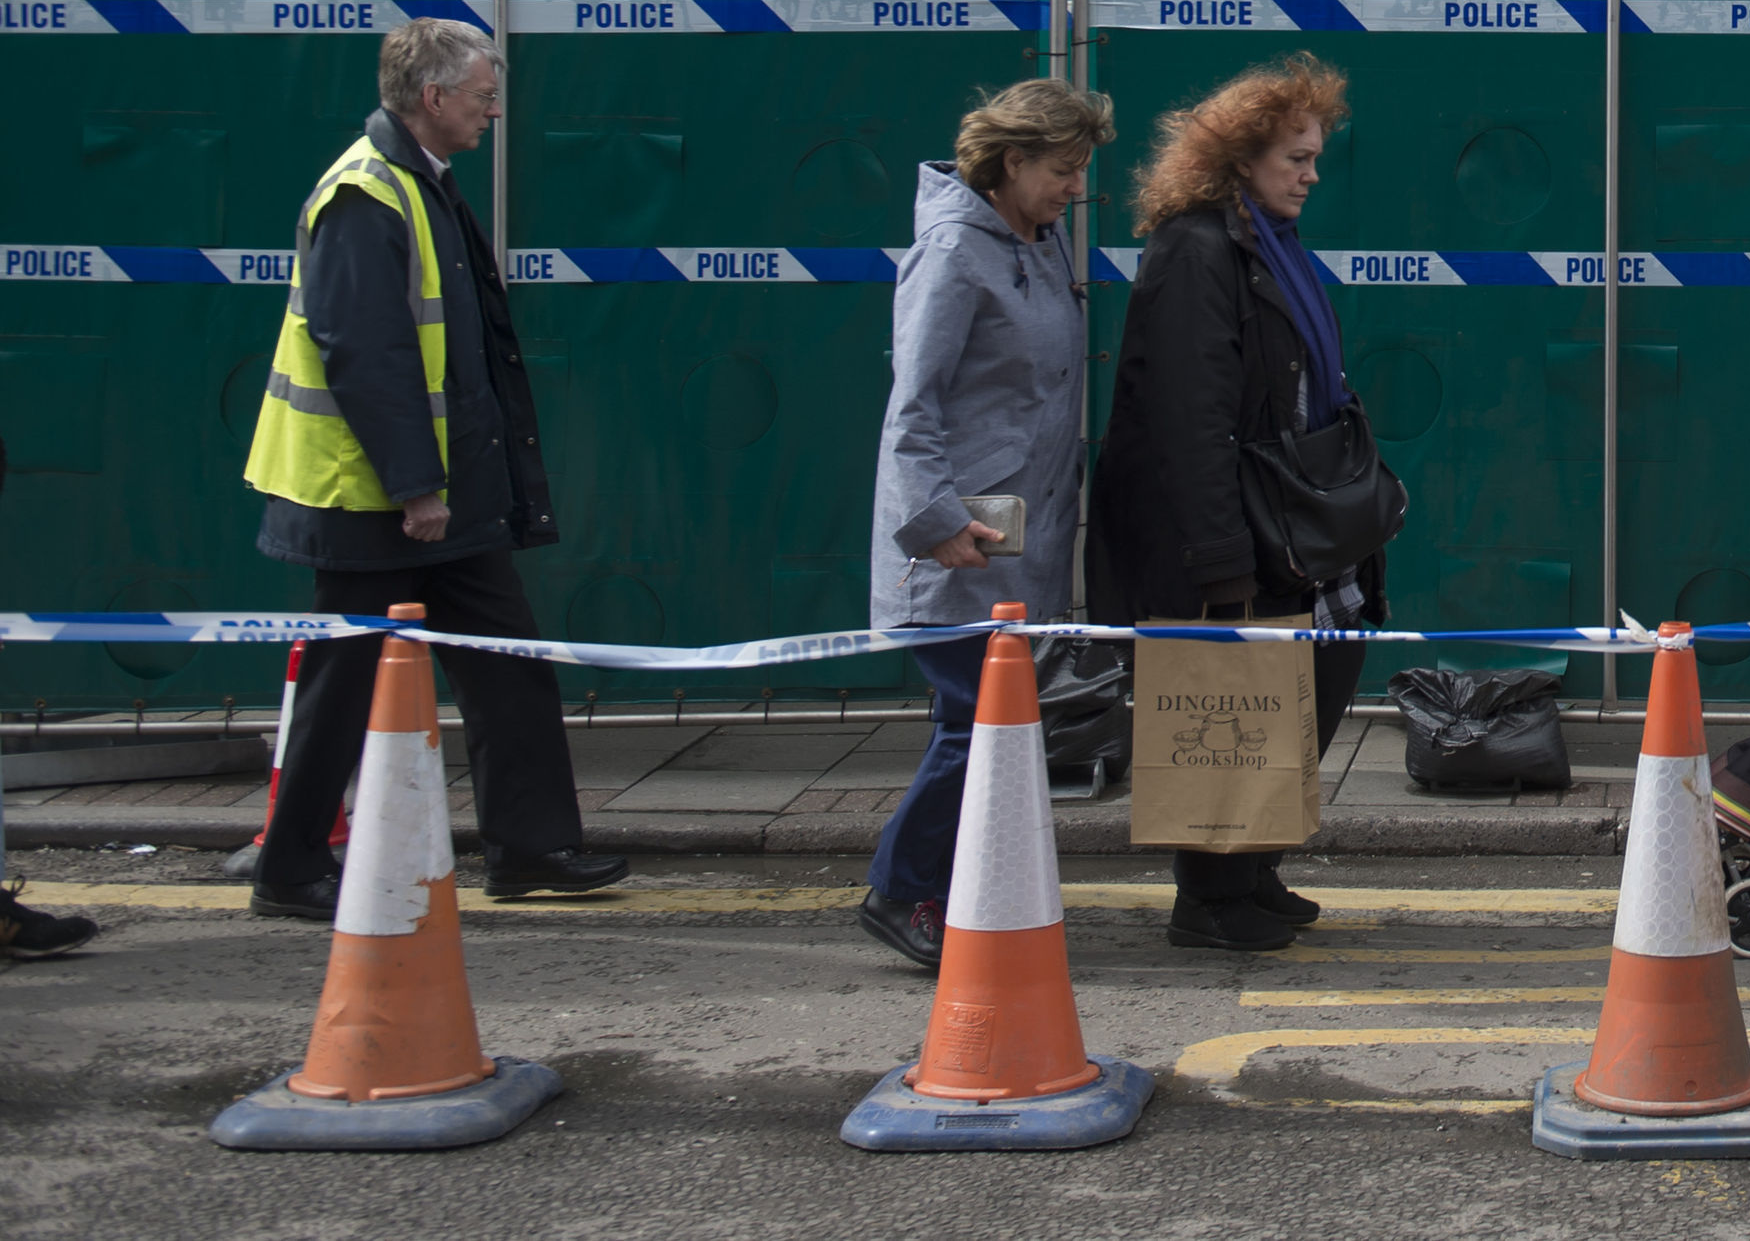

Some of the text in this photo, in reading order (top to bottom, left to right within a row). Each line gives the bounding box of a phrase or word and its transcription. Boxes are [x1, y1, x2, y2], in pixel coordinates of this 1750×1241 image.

[0, 3, 66, 28] LICE
[273, 3, 373, 28] POLICE
[576, 3, 674, 28] POLICE
[873, 2, 969, 27] POLICE
[1160, 0, 1252, 25] POLICE
[1444, 2, 1538, 27] POLICE
[7, 250, 92, 277] POLICE
[240, 255, 294, 281] POLI
[697, 252, 779, 279] POLICE
[1351, 255, 1430, 282] POLICE
[1566, 257, 1646, 283] POLCE
[1157, 695, 1281, 712] DINGHAMS
[1172, 750, 1267, 770] Cookshop
